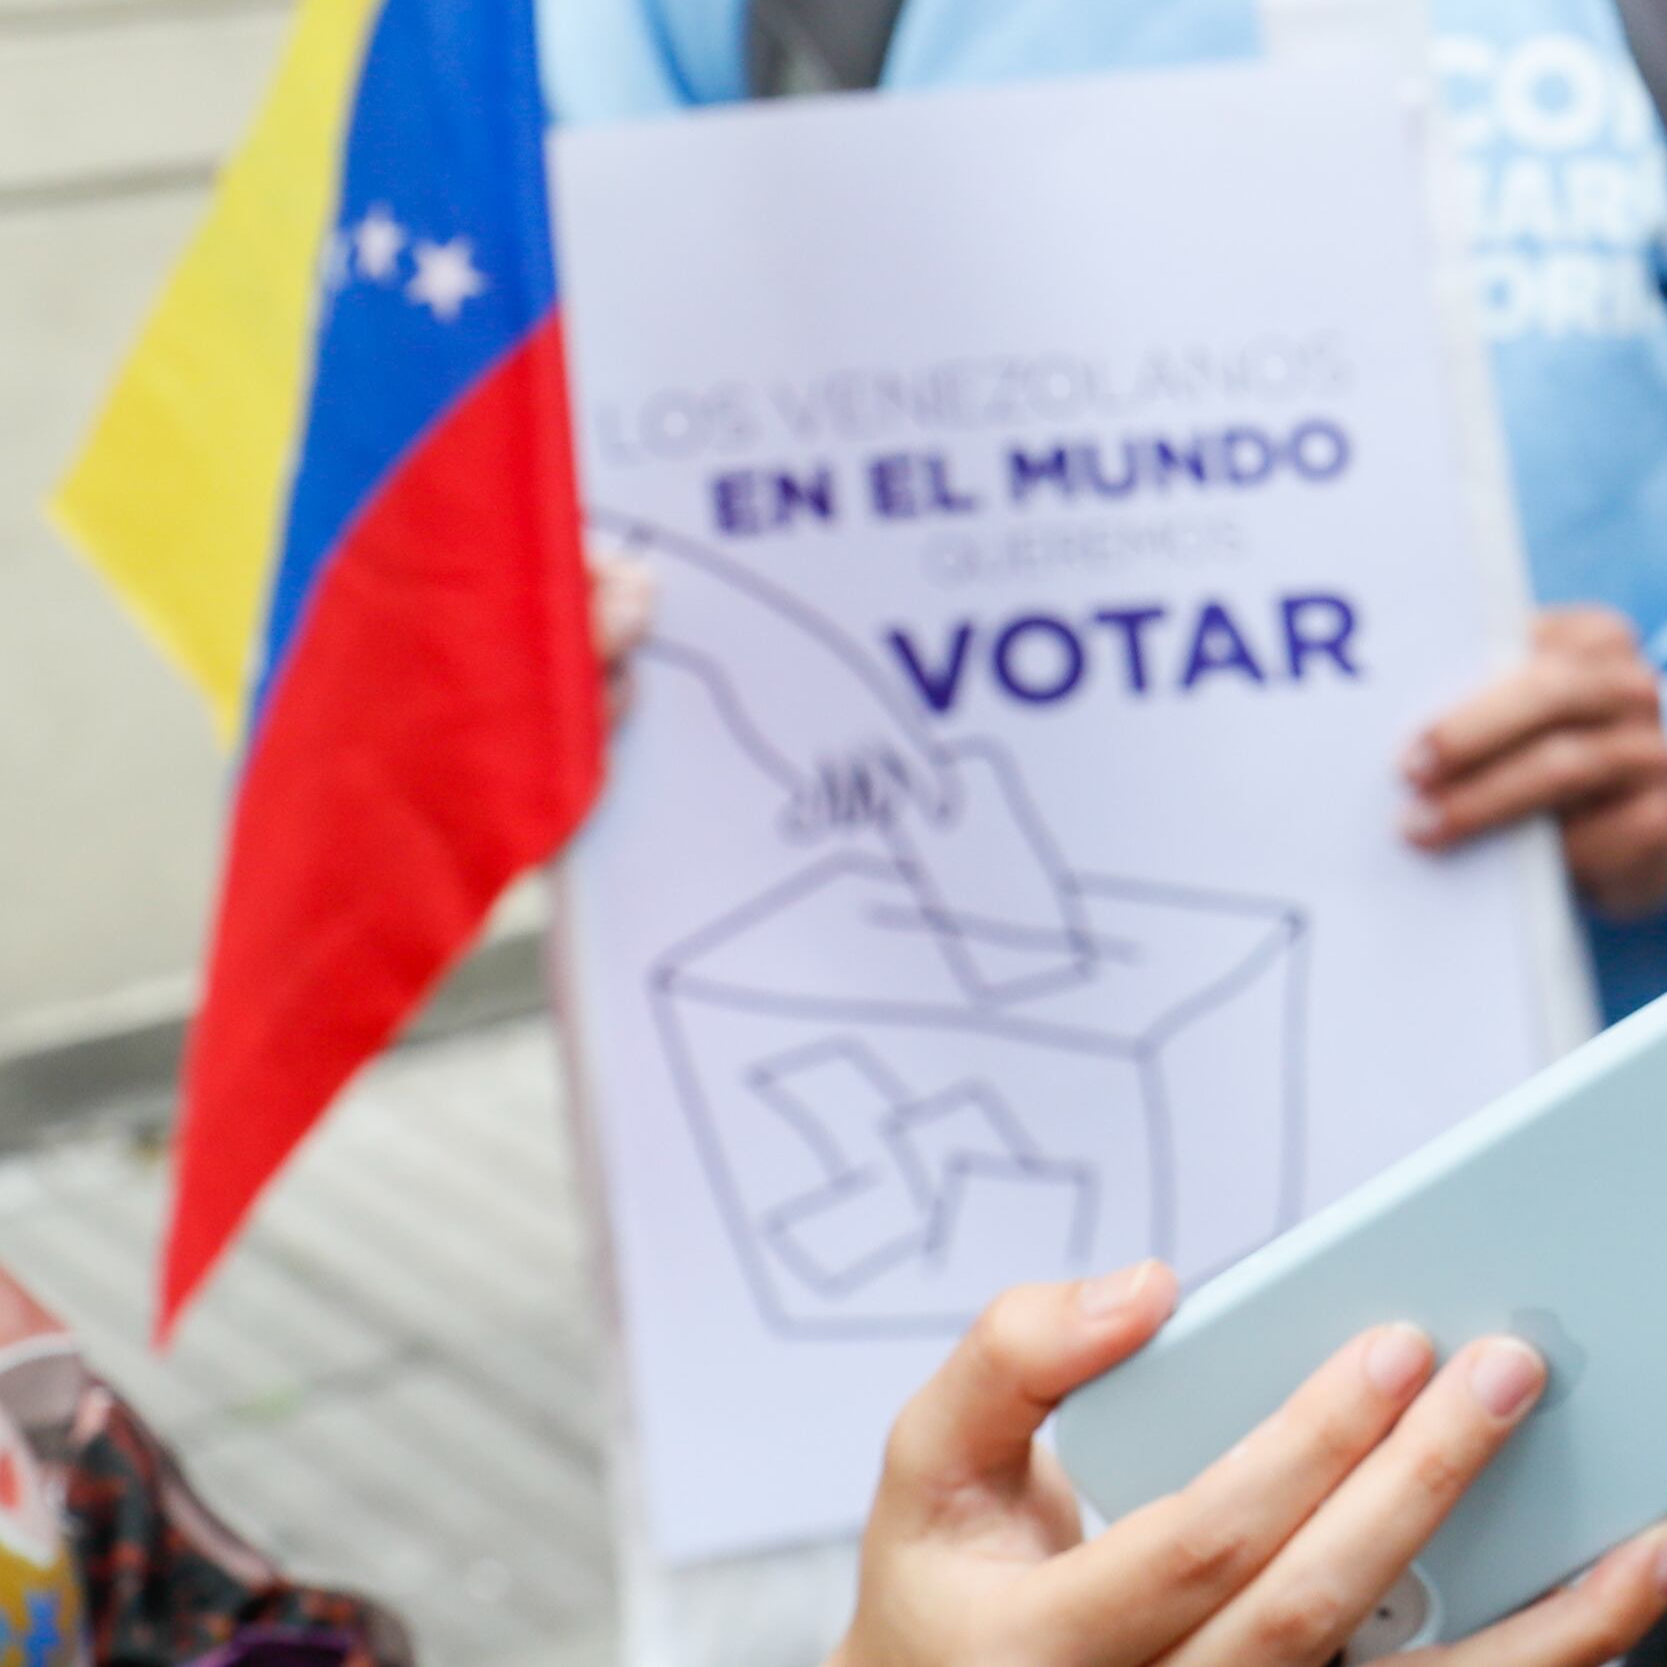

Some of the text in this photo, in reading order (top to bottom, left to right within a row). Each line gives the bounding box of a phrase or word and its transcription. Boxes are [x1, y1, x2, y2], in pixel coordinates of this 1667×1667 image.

[595, 328, 1357, 468] LOS VENEZOLANOS
[710, 418, 1351, 537] EN EL MUNDO
[888, 592, 1362, 714] VOTAR
